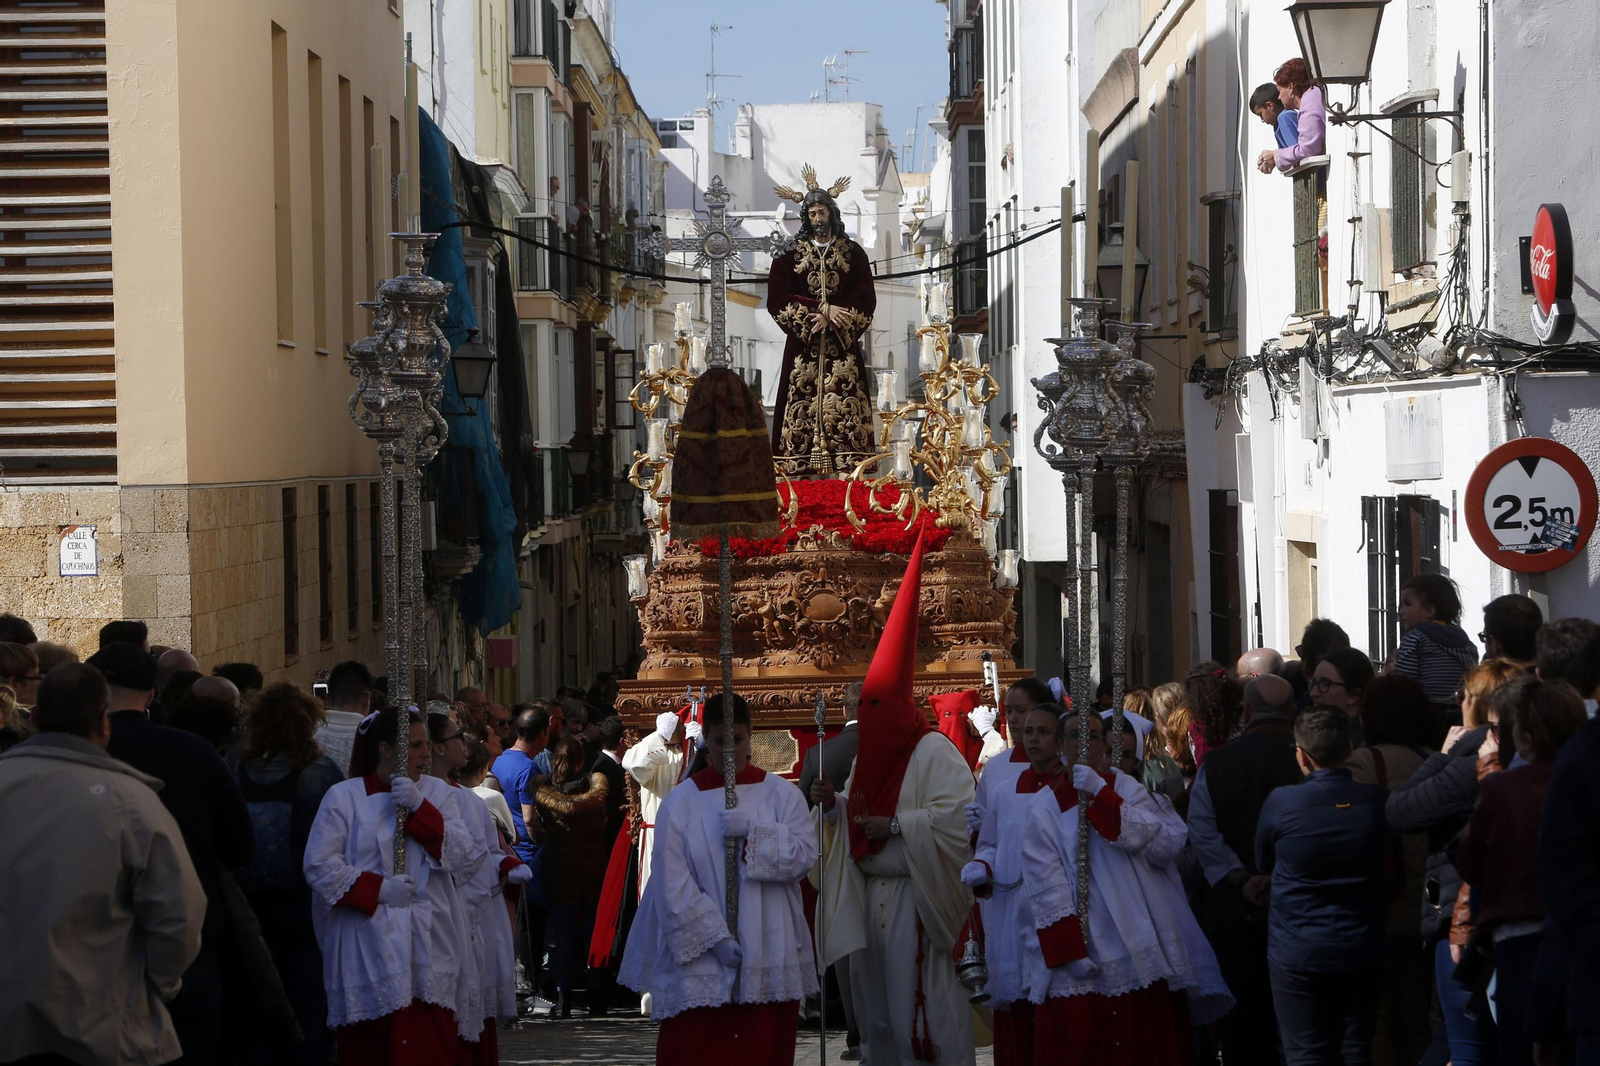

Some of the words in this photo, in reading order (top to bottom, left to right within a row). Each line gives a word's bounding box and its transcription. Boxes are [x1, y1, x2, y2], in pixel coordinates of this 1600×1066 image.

[67, 532, 87, 540] CALLE
[67, 542, 87, 550] CERCA
[74, 552, 82, 560] DE
[61, 563, 95, 571] CAPUCHINOS
